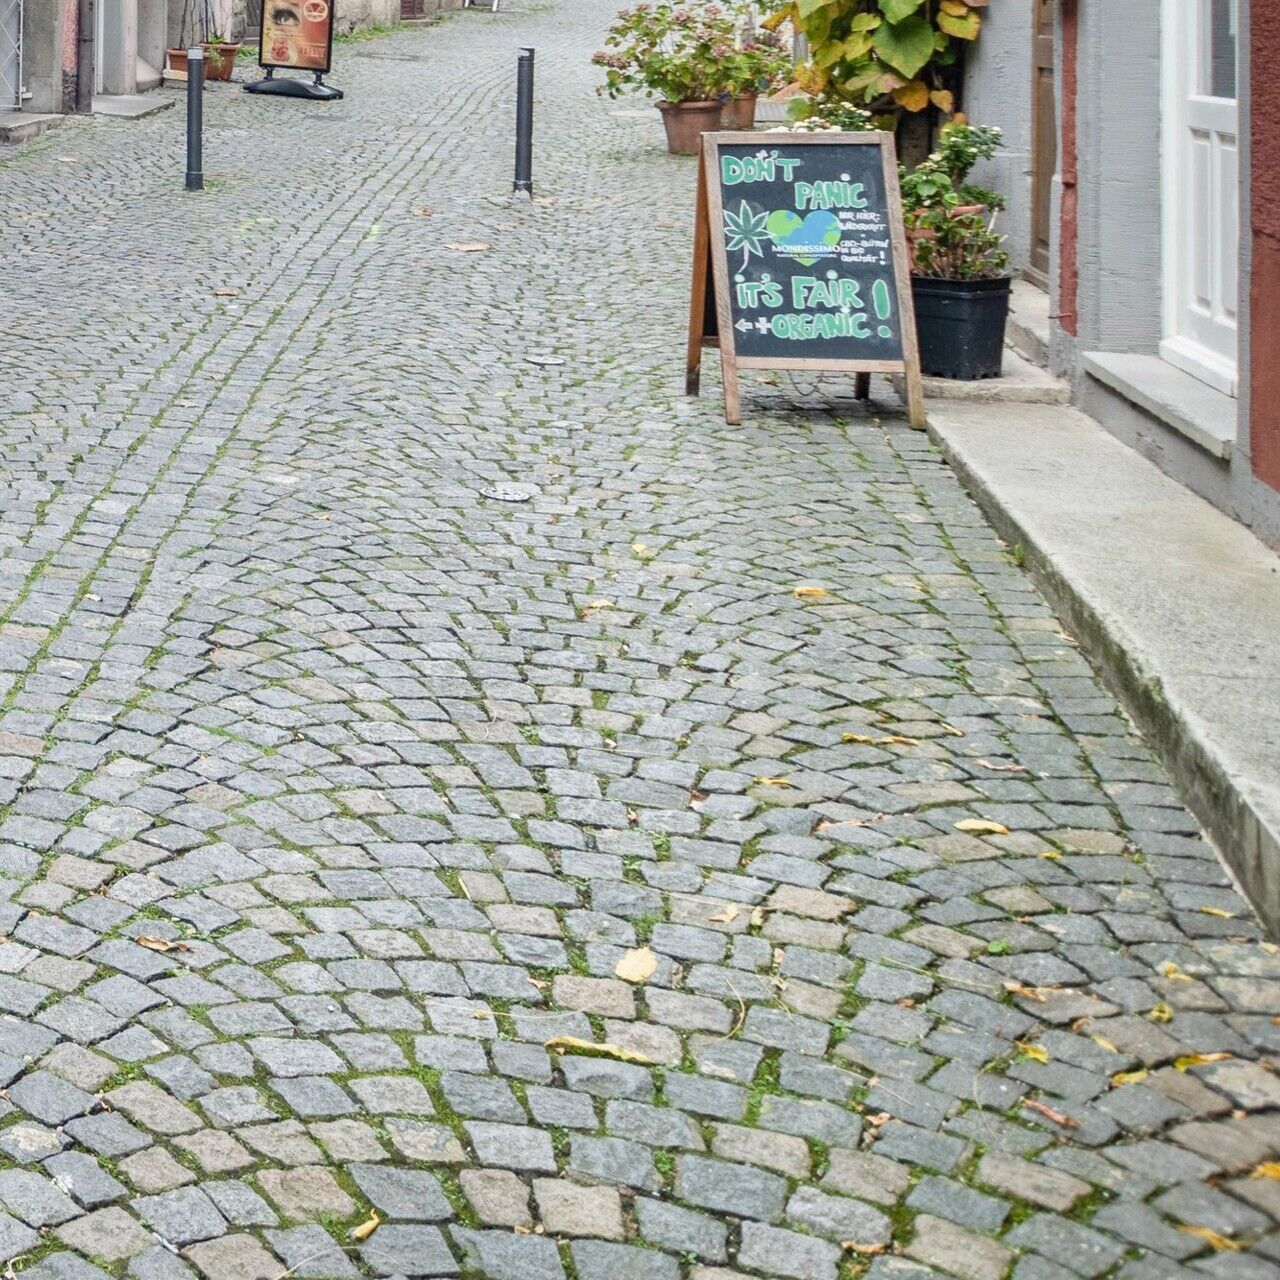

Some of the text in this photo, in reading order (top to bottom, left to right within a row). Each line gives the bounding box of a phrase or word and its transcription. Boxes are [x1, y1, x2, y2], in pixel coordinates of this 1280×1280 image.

[721, 149, 801, 185] DON'T
[794, 173, 868, 209] PANIC
[772, 245, 840, 253] MONDISSIMO
[734, 273, 784, 309] IT'S
[792, 270, 864, 309] FAIR
[771, 306, 871, 340] ORGANIC
